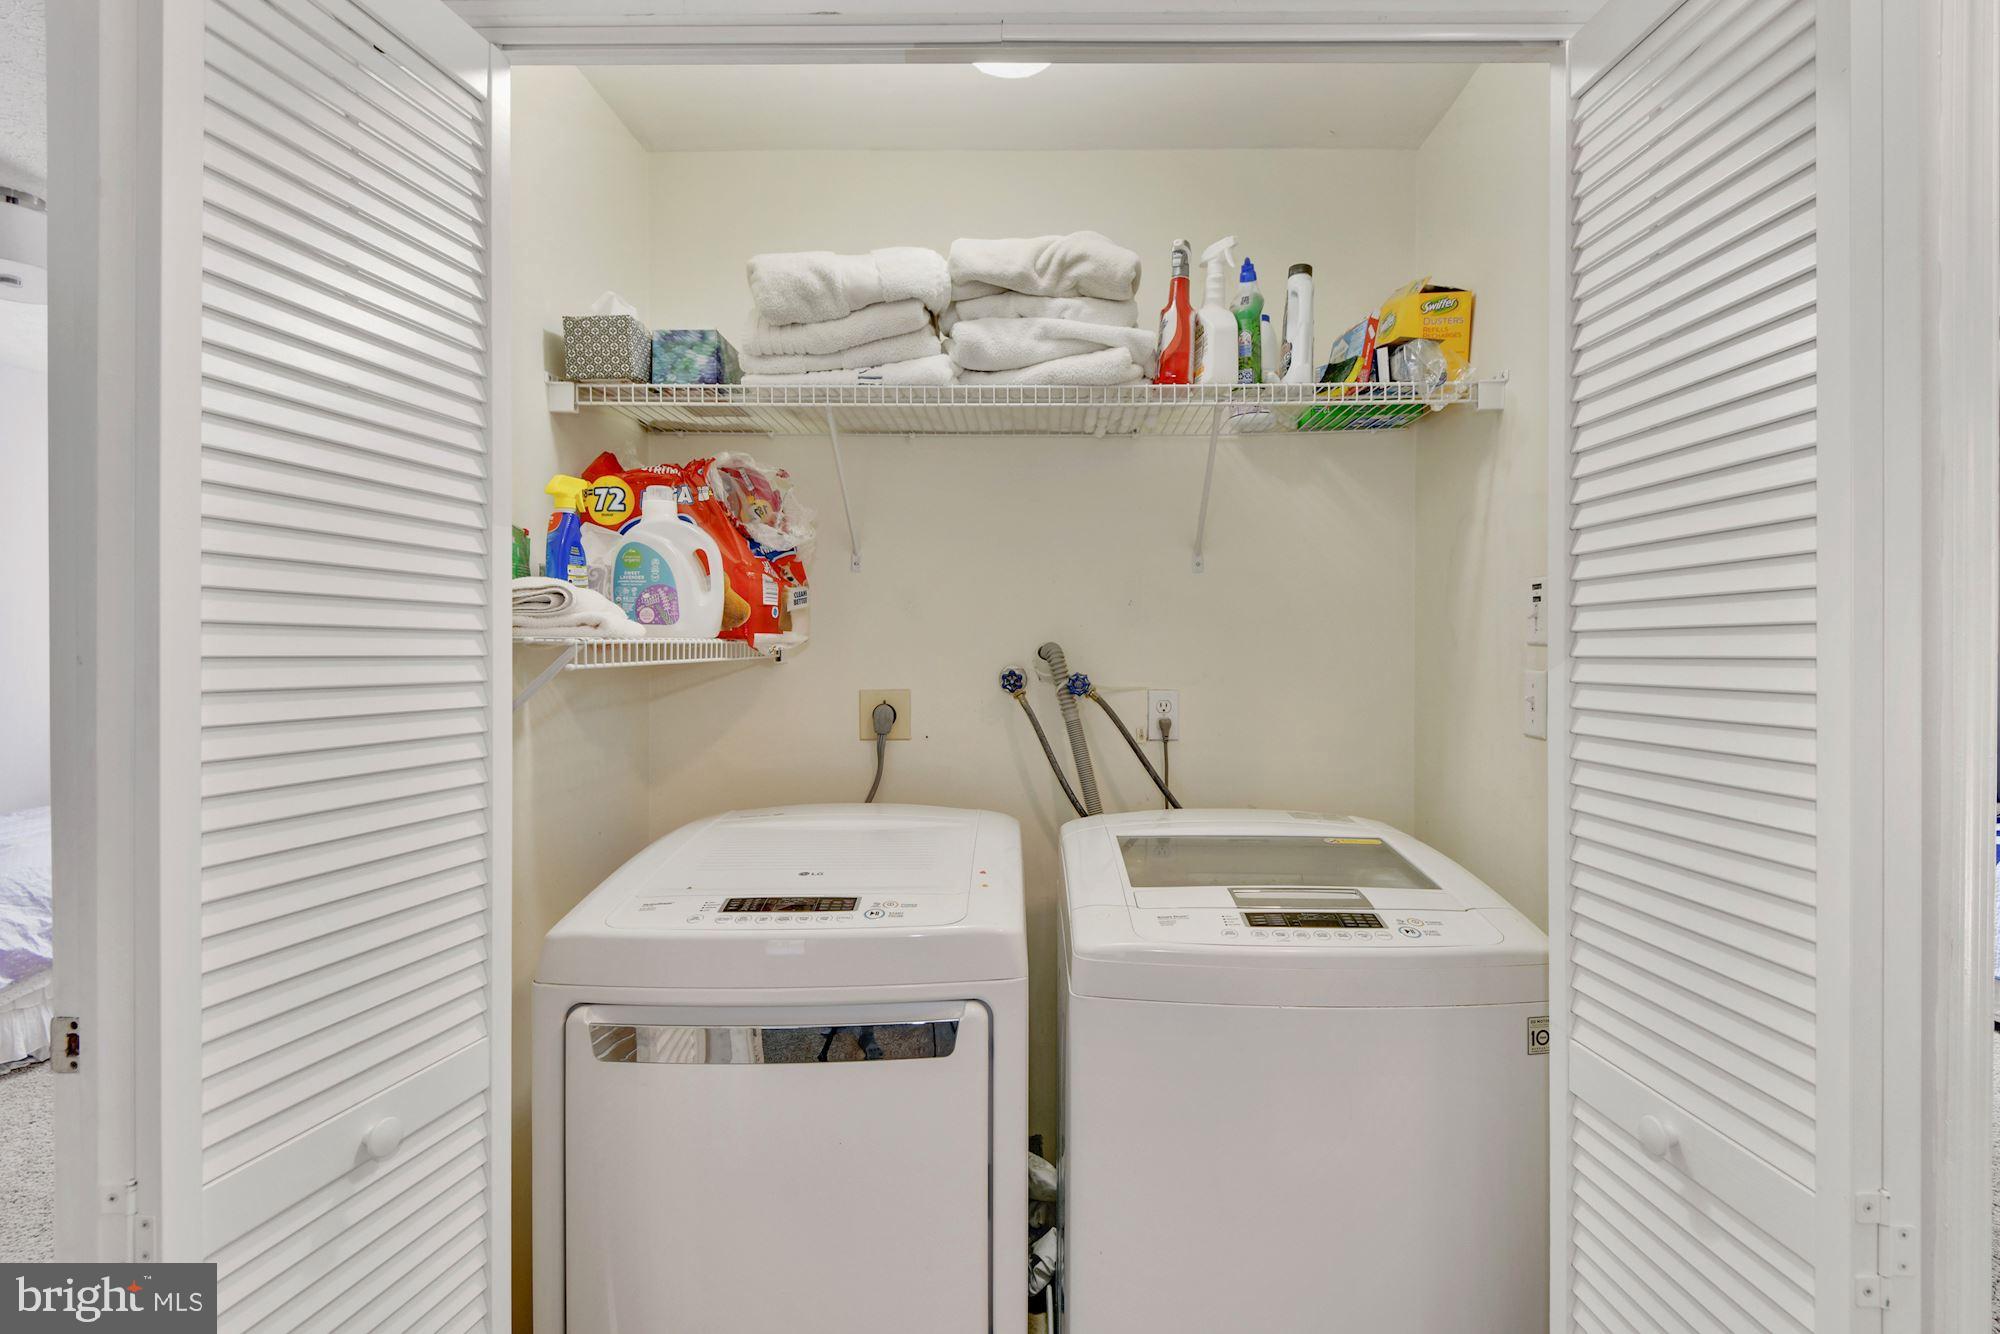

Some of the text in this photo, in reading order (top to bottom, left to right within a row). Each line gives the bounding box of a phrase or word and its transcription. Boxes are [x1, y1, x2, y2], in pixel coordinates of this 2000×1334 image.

[1422, 297, 1457, 314] Swiffer
[1423, 316, 1465, 326] DUSTERS
[593, 486, 627, 512] 72
